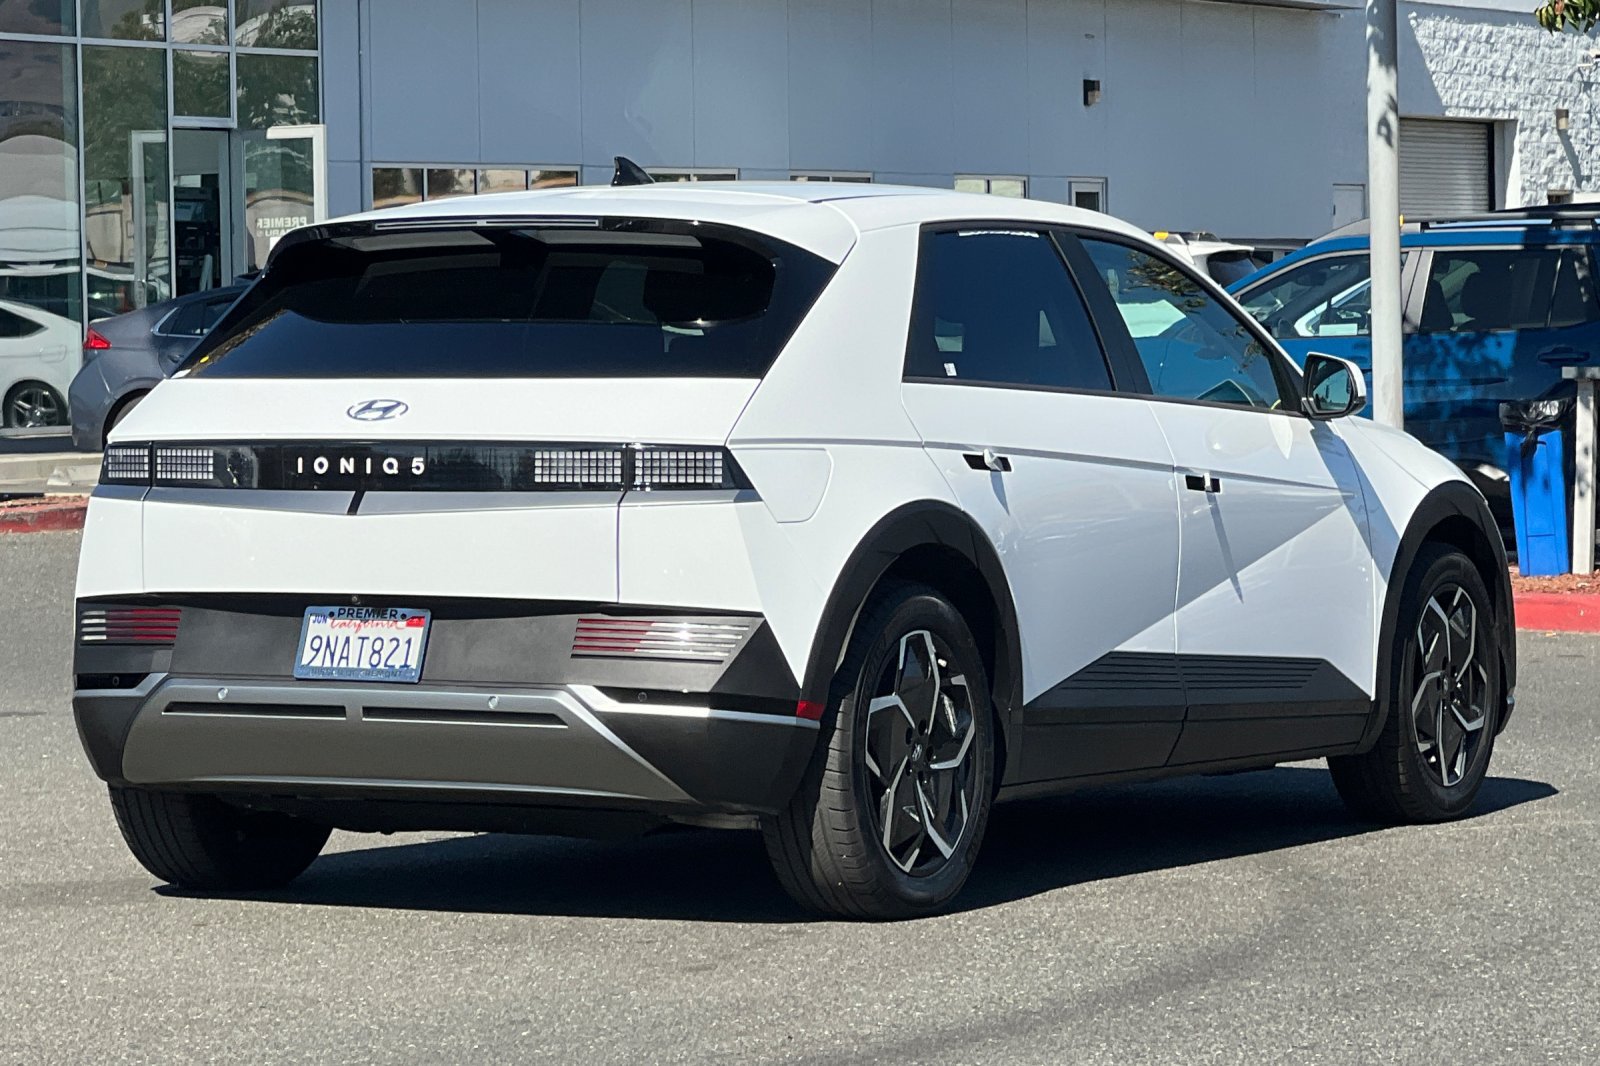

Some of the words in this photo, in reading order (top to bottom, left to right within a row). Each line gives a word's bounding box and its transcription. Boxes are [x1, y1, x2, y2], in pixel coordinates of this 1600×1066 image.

[296, 456, 399, 475] IONIQ
[411, 457, 425, 475] 5
[312, 614, 328, 624] JUN
[337, 607, 399, 620] PREMIER
[329, 618, 405, 633] California
[308, 635, 412, 669] 9NAT821
